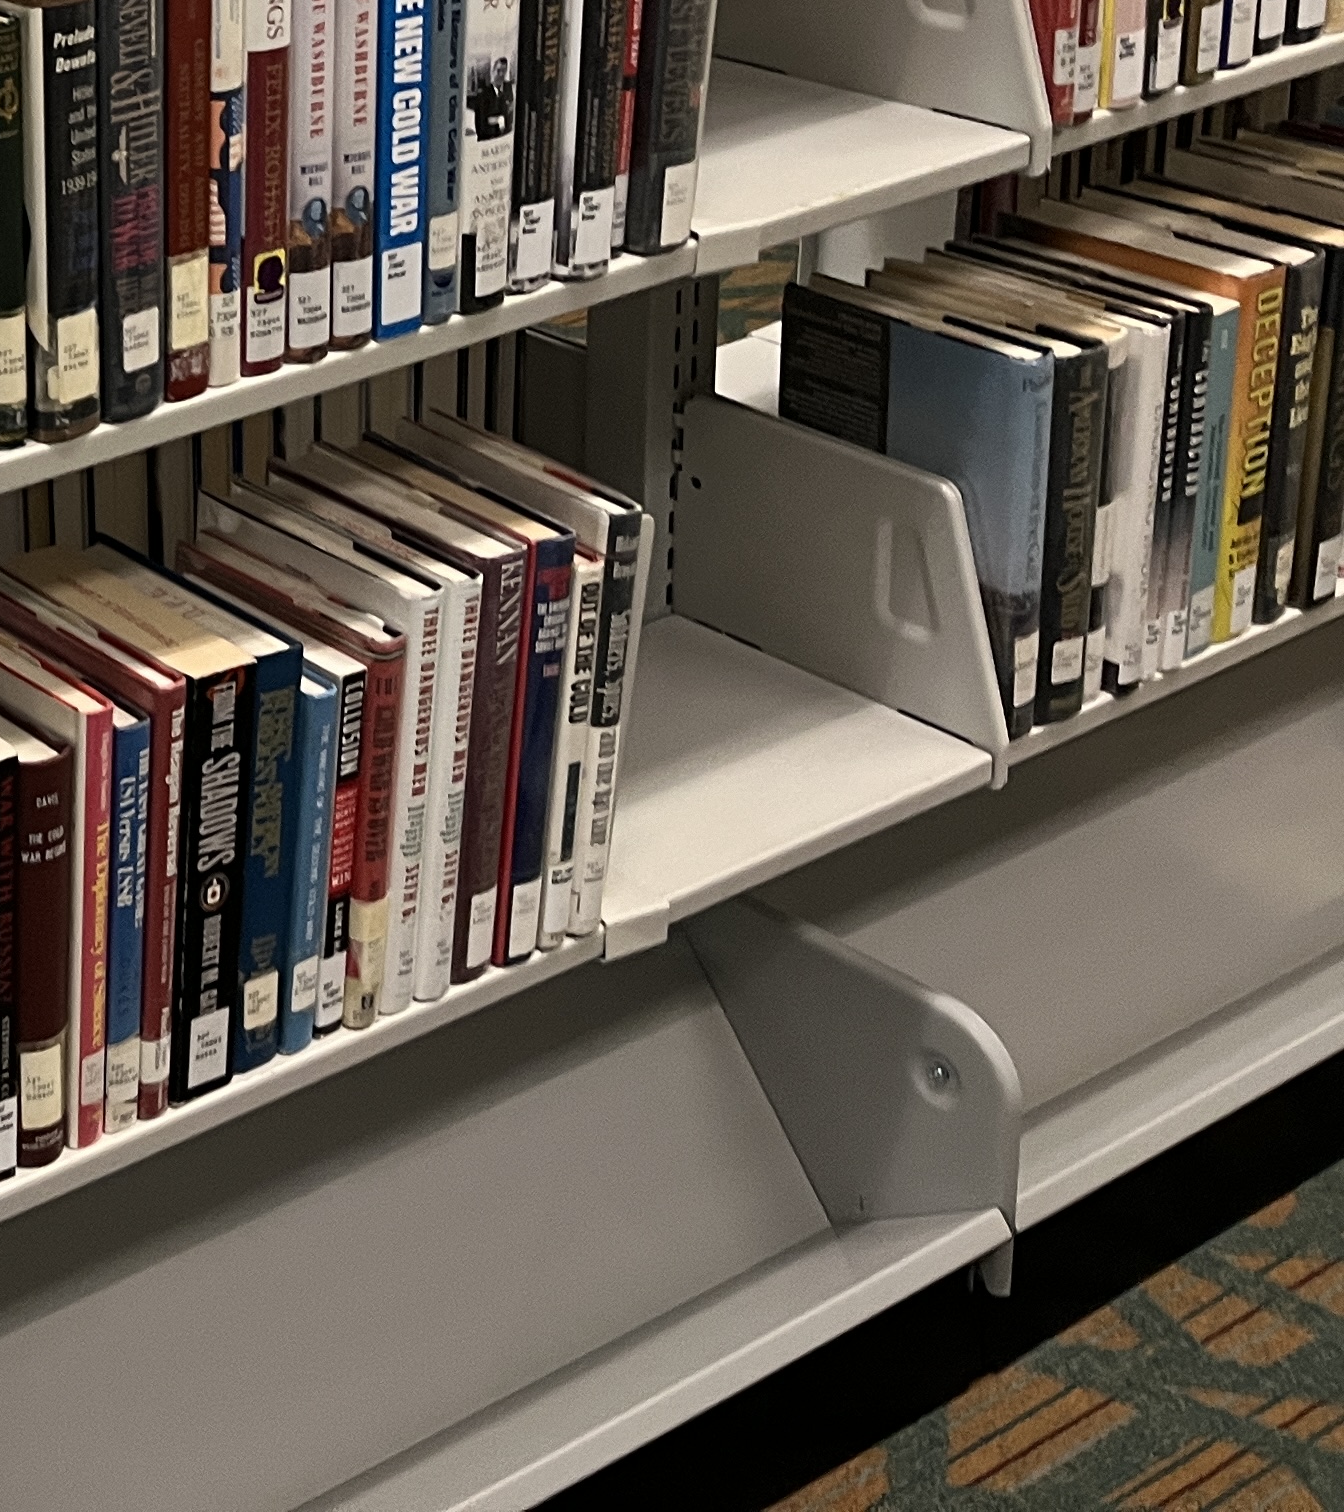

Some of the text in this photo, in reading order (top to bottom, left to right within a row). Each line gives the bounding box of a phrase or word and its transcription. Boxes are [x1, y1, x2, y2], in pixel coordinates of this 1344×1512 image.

[109, 68, 154, 94] &
[307, 21, 327, 139] WASHBURNE
[350, 10, 370, 127] WASHBURNE
[392, 14, 425, 84] NEW
[109, 89, 165, 185] HITLER
[262, 63, 283, 135] FELIX
[390, 86, 422, 166] COLD
[388, 164, 421, 237] WAR
[1234, 284, 1286, 501] DECEPTION
[490, 557, 526, 666] KENNAN
[338, 679, 365, 777] COLLUSION
[410, 605, 439, 797] THREE DANGEROUS MEN
[451, 594, 480, 783] THREE DANGEROUS MEN
[0, 775, 13, 828] WAR
[191, 748, 244, 875] SHADOWS
